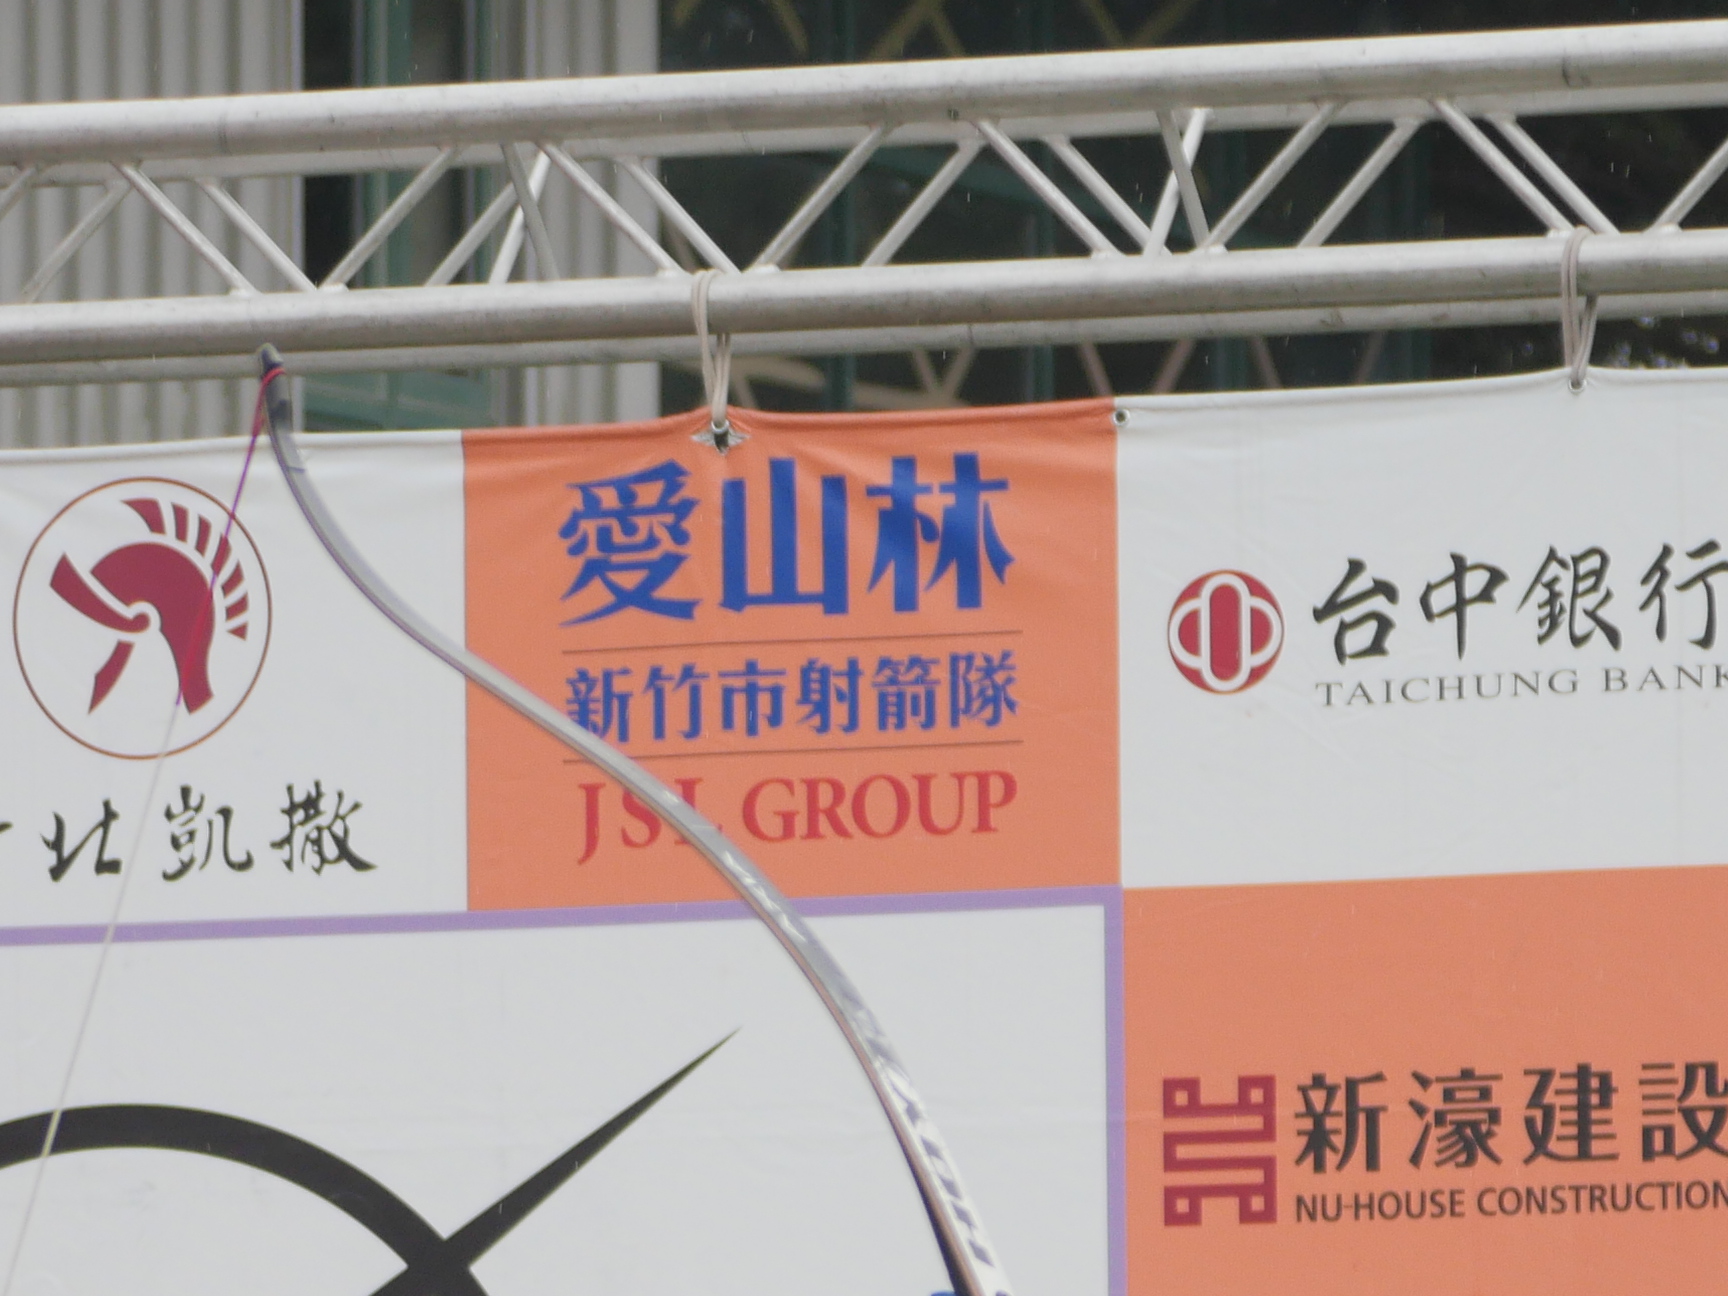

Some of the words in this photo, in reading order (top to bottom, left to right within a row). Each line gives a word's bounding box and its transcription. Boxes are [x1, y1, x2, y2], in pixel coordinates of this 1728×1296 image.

[558, 452, 1015, 627] 愛山林
[566, 650, 1019, 743] 新竹市射箭隊
[1315, 668, 1579, 707] TAICHUNG
[742, 770, 1018, 844] GROUP
[1295, 1188, 1465, 1224] NU-HOUSE
